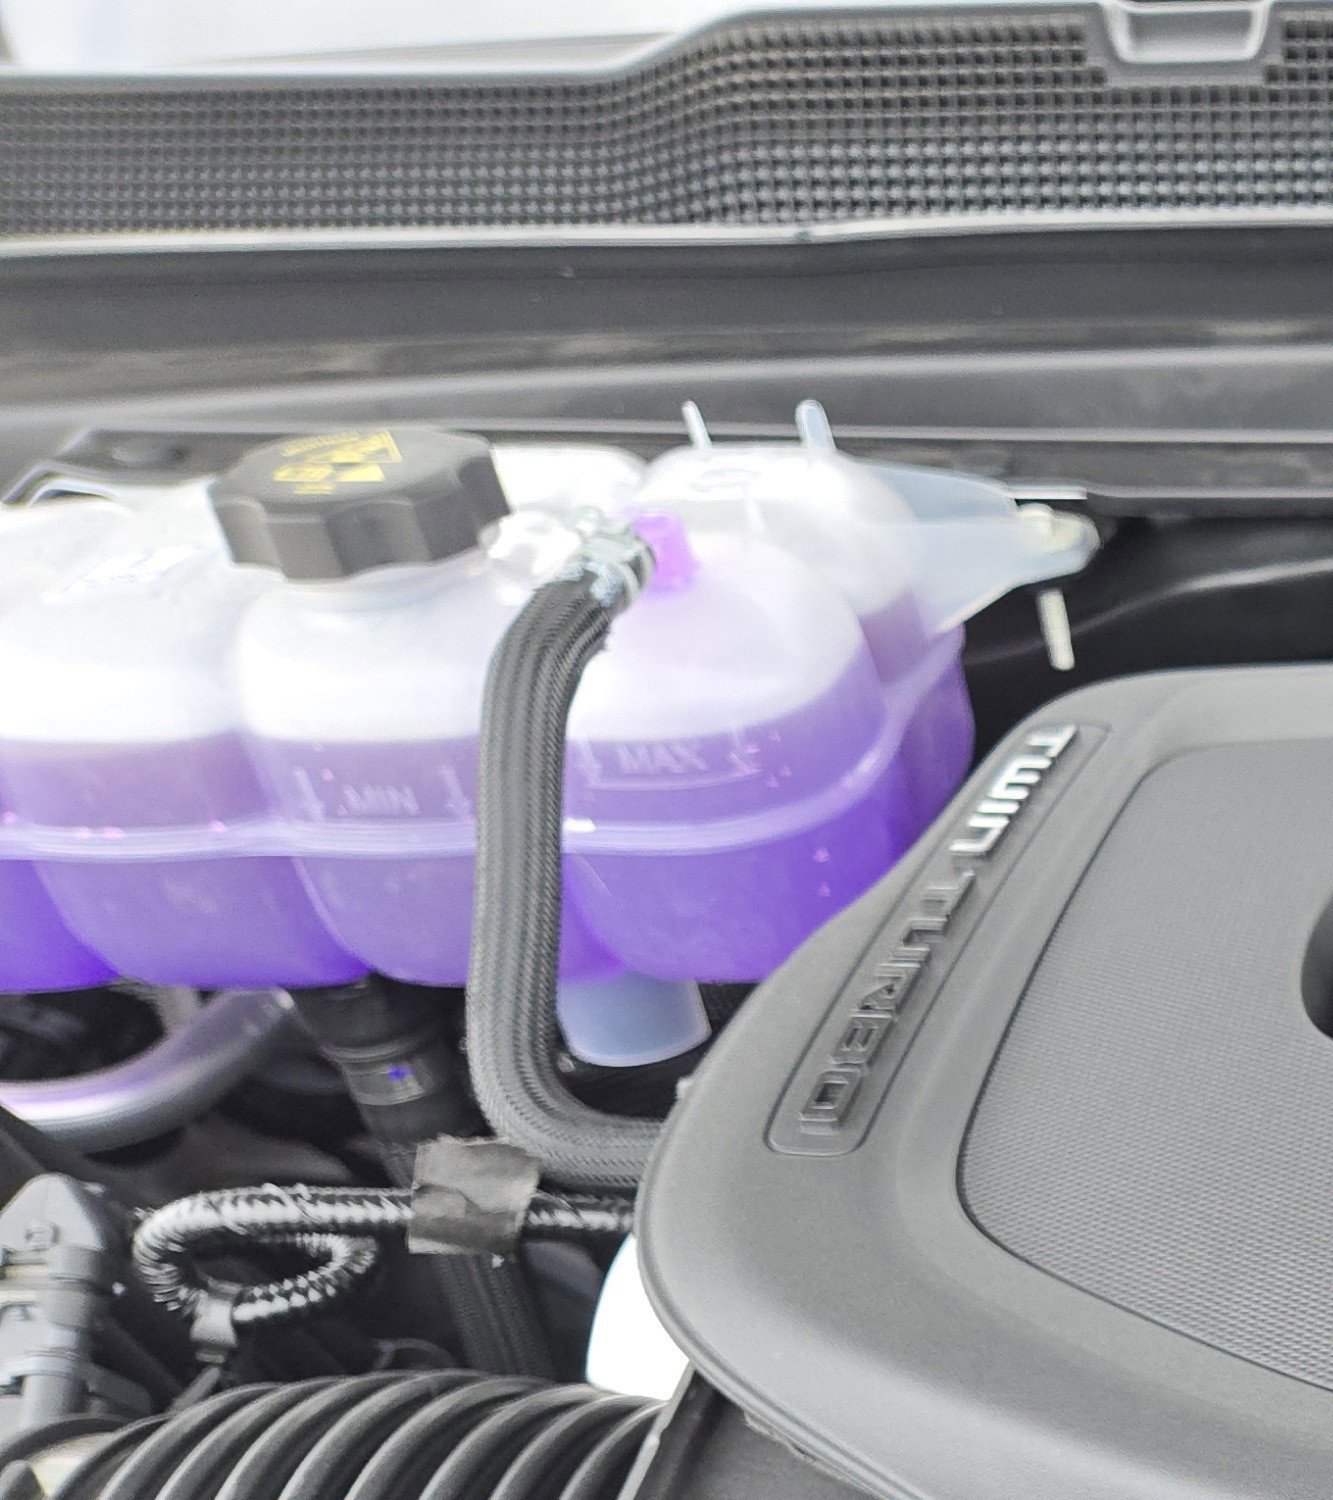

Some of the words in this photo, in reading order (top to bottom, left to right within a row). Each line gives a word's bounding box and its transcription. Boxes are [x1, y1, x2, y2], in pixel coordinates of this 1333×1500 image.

[615, 741, 708, 774] MAX
[341, 783, 421, 817] MIN
[798, 868, 977, 1134] TURBO
